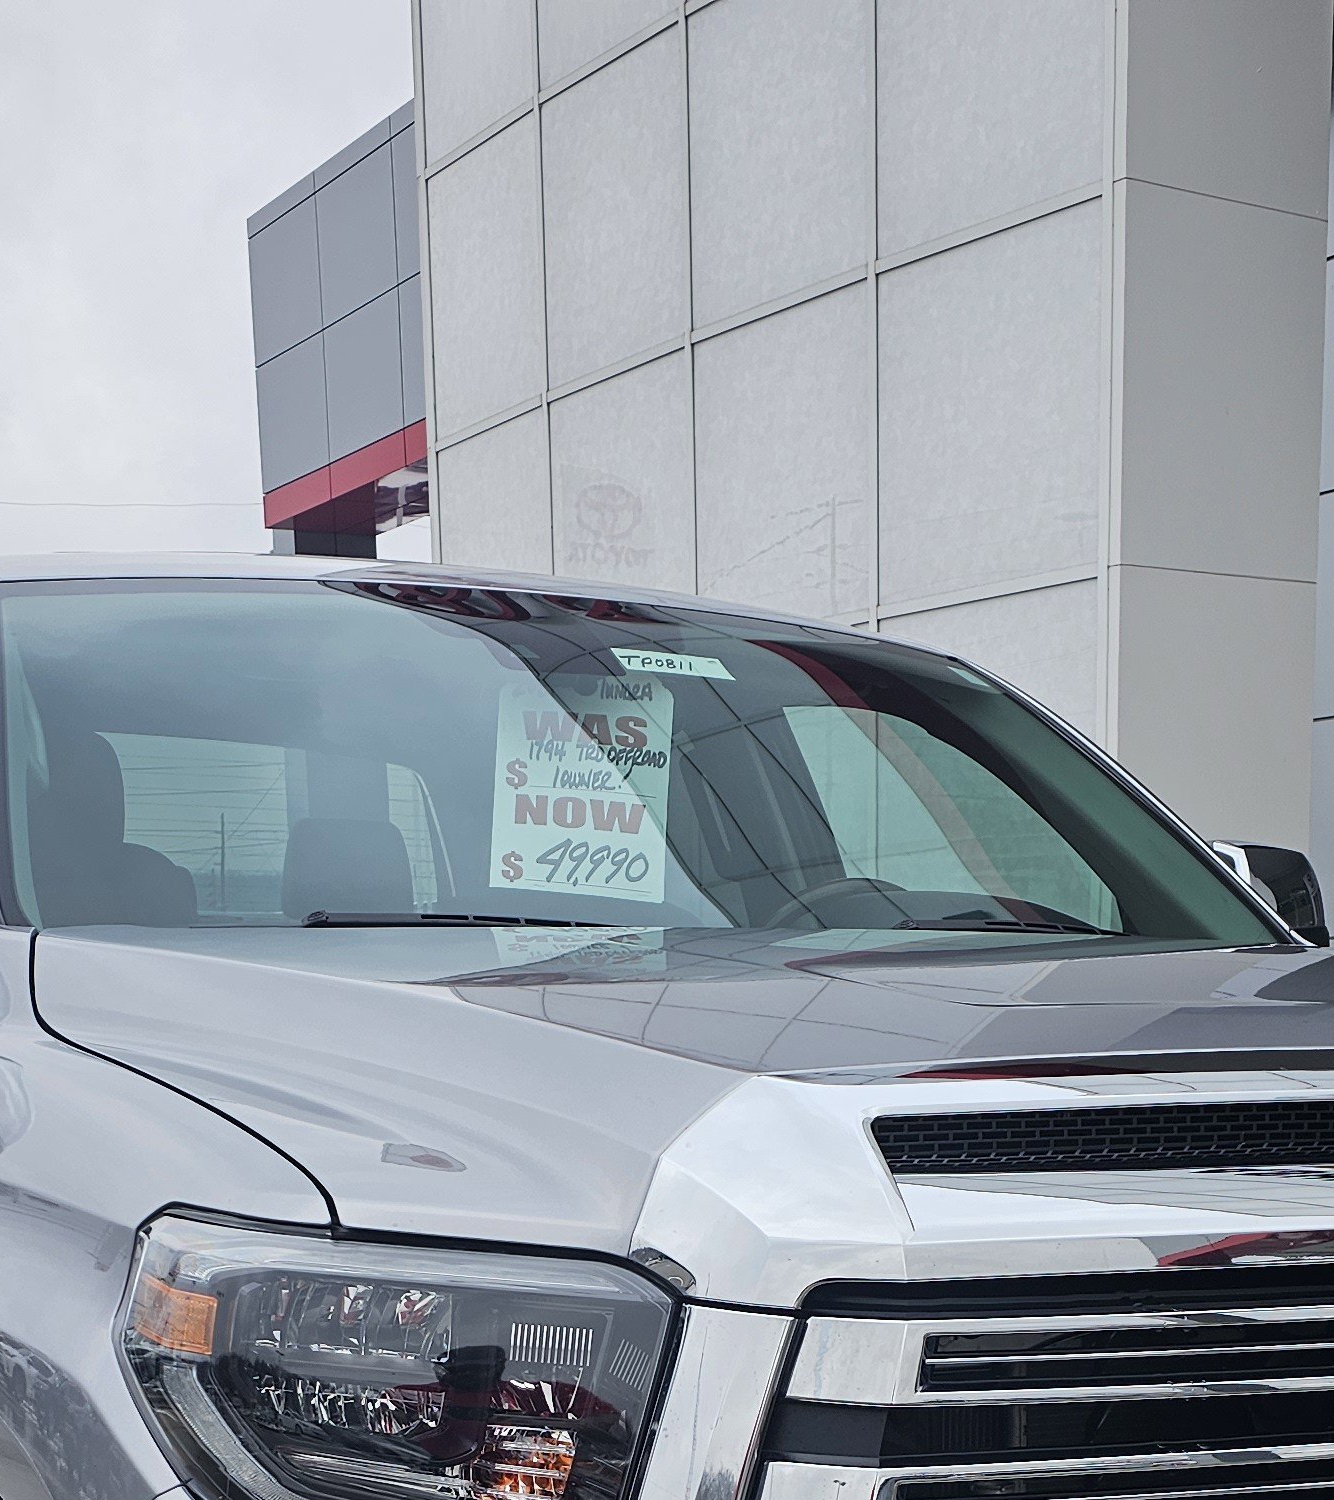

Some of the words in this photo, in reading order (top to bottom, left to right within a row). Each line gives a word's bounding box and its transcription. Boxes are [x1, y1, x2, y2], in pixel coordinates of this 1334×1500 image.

[522, 711, 649, 748] WAS
[529, 739, 567, 762] 1794
[505, 757, 528, 789] $
[514, 794, 646, 834] NOW
[501, 850, 524, 882] $
